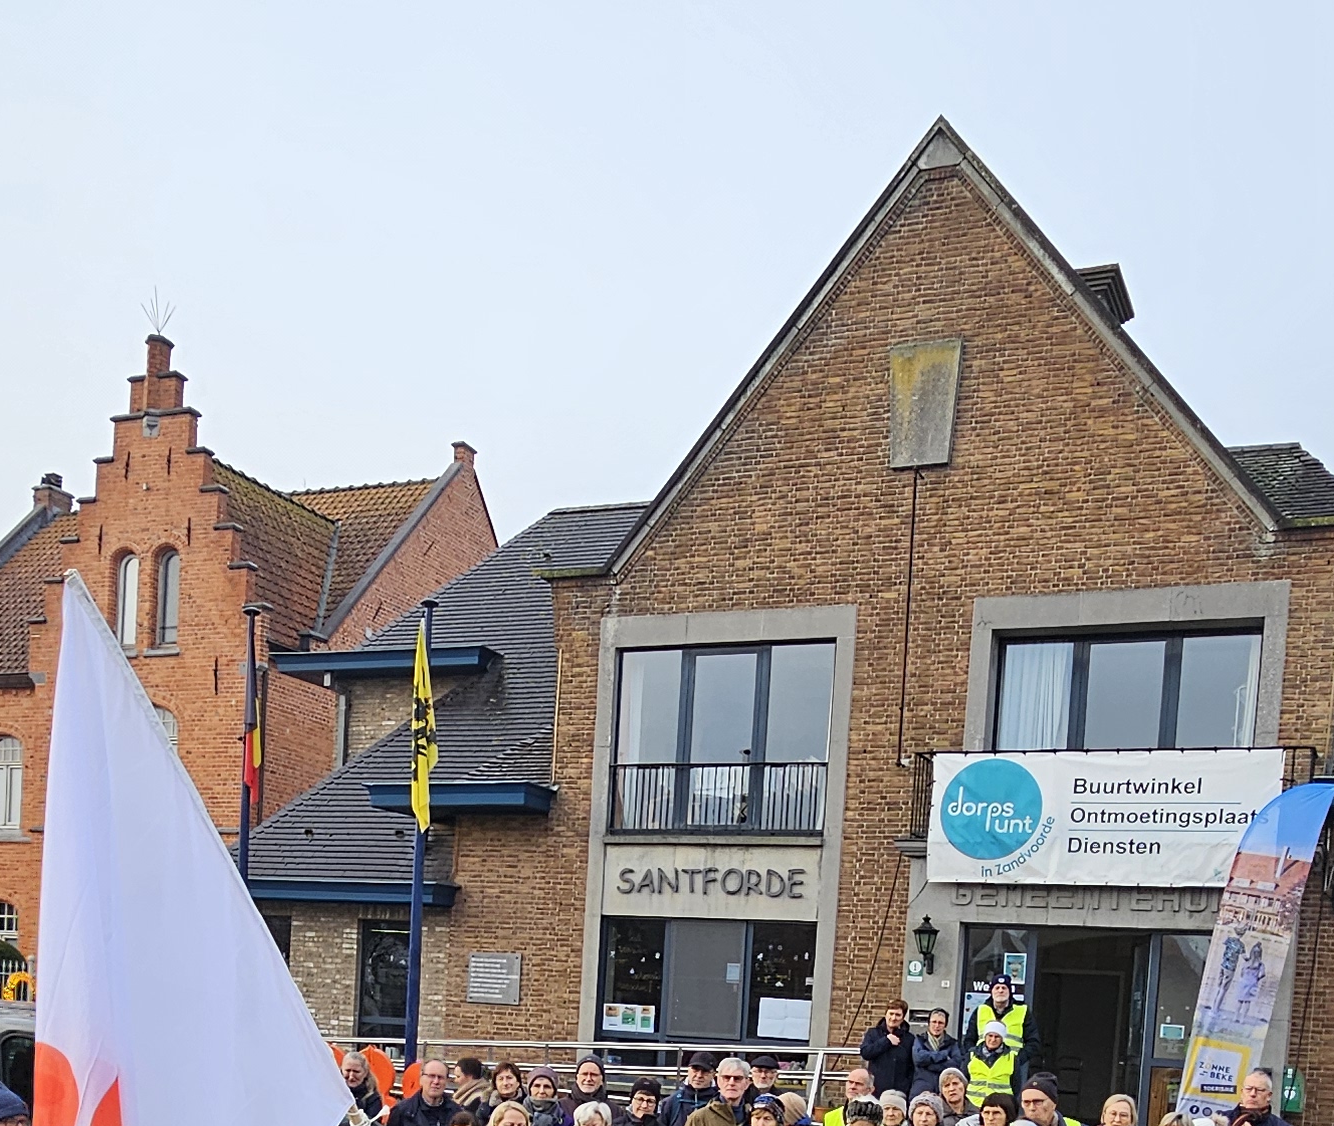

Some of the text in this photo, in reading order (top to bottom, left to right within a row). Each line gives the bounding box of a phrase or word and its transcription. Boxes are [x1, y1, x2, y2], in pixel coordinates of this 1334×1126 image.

[1073, 778, 1203, 795] Buurtwinkel
[981, 816, 1055, 877] in Zandvoorde
[1067, 837, 1161, 855] Diensten
[617, 867, 807, 899] SANTFORDE
